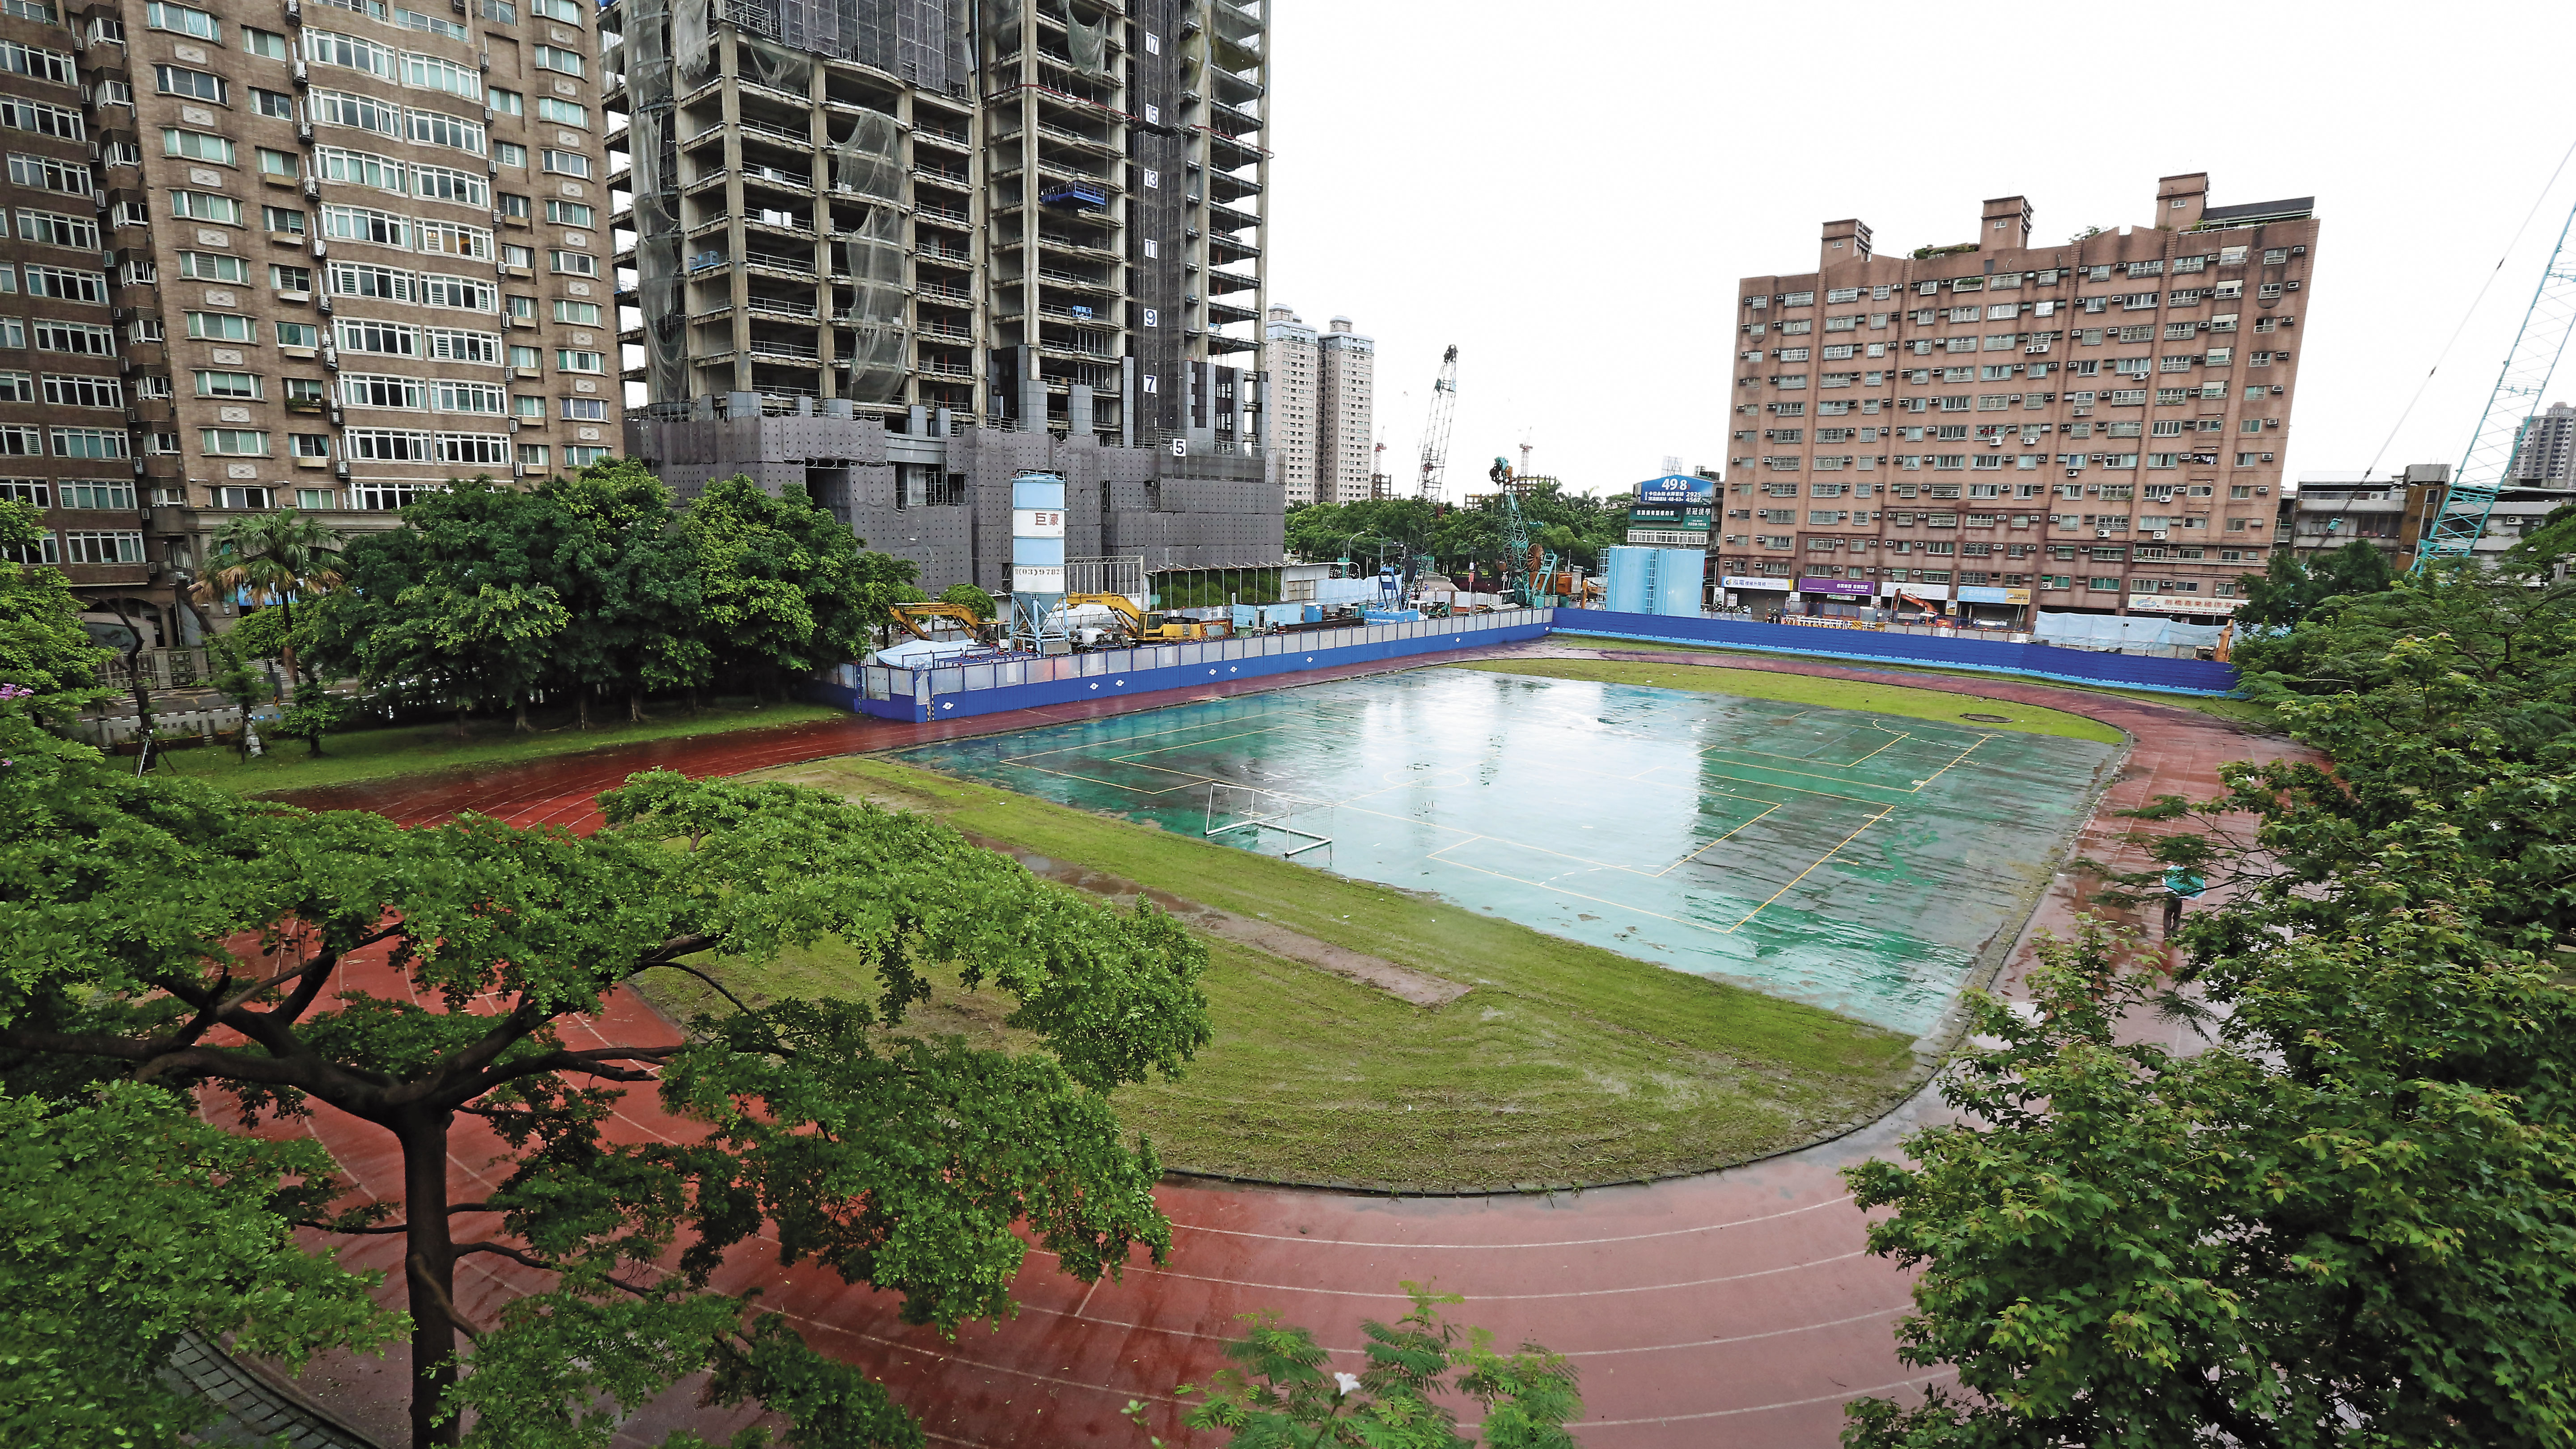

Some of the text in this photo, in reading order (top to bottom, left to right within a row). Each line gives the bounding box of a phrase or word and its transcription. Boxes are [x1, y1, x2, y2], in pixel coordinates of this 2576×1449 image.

[1147, 34, 1157, 54] 17
[1147, 106, 1157, 123] 15
[1145, 171, 1157, 186] 13
[1145, 240, 1157, 258] 11
[1146, 310, 1156, 325] 9
[1146, 376, 1155, 391] 7
[1176, 441, 1184, 455] 5
[1035, 513, 1059, 525] 巨豪
